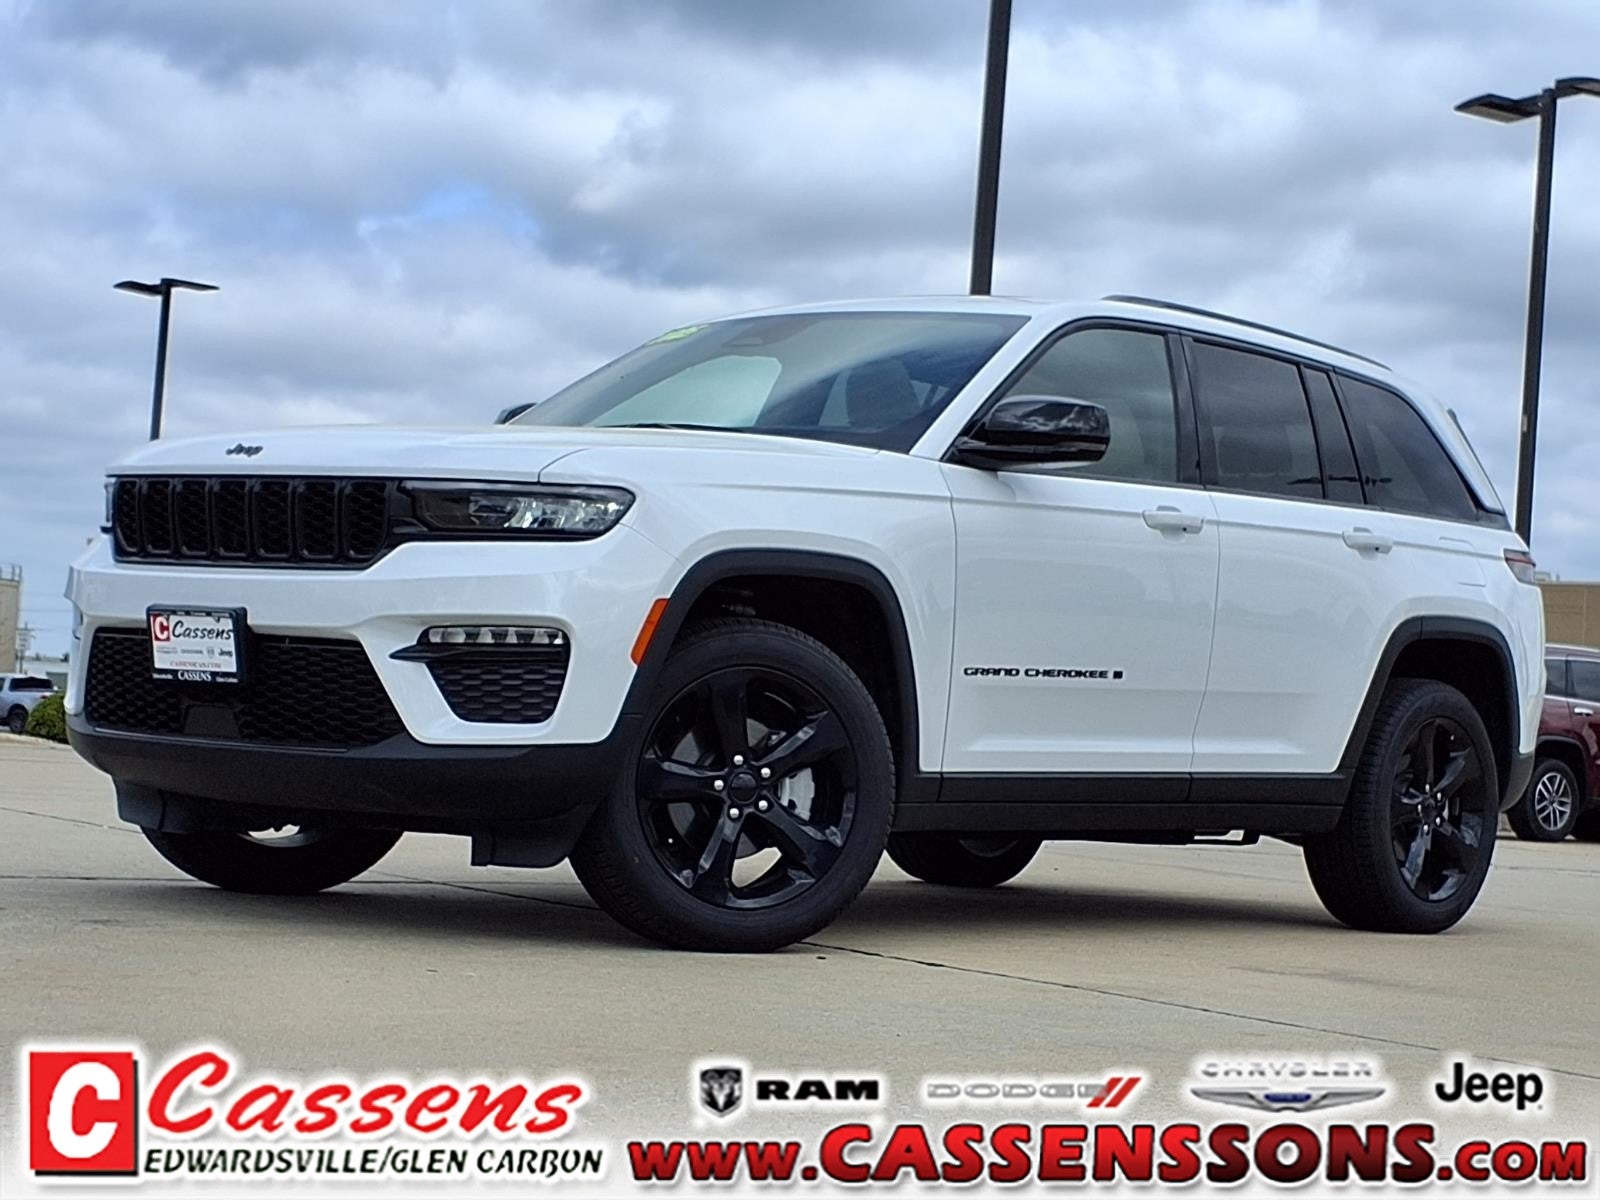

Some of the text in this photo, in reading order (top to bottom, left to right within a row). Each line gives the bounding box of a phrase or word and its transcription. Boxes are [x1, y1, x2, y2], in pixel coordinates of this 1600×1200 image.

[172, 620, 234, 640] Cassens
[177, 670, 212, 682] CASSENS
[963, 667, 1108, 679] GRAND CHEROKEE
